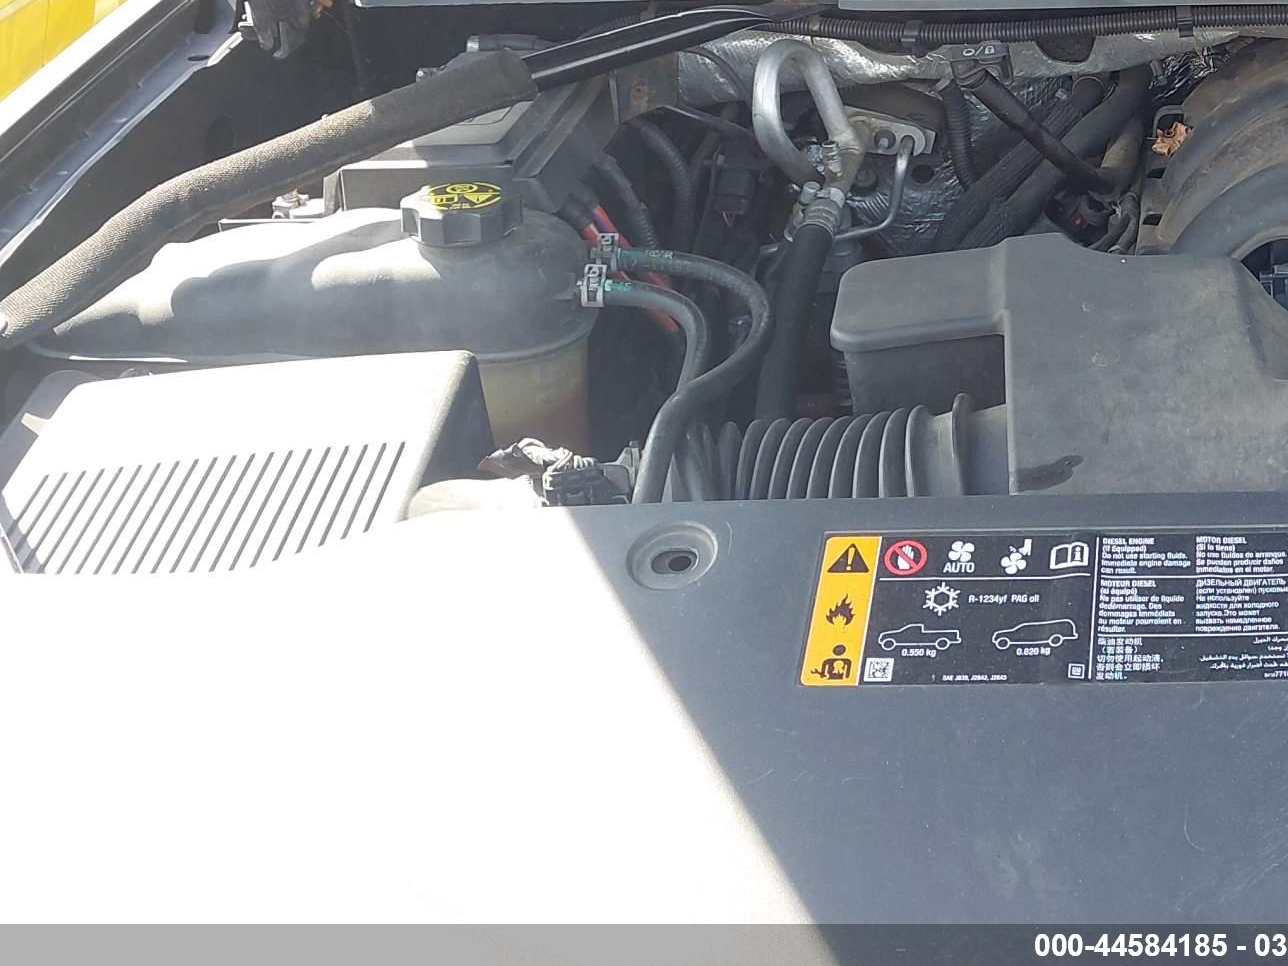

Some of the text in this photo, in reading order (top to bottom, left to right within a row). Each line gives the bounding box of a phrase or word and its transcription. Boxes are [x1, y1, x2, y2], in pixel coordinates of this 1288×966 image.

[1102, 537, 1155, 545] DIESEL ENGINE
[1196, 536, 1221, 544] MOTOR
[1111, 545, 1147, 553] Equipped)
[1139, 552, 1166, 560] starting
[1139, 560, 1162, 568] engine
[1163, 559, 1191, 568] damage
[1206, 559, 1232, 567] pueden
[1233, 558, 1262, 567] producir
[943, 562, 975, 573] AUTO
[1131, 580, 1157, 588] DIESEL
[1196, 578, 1286, 587] ДИЗЕЛЬНЫЙ ДВИГАТЕЛЬ
[968, 594, 1008, 604] R-1234yf
[1011, 594, 1028, 602] PAG
[1110, 595, 1124, 603] pas
[1161, 595, 1185, 603] liquide
[1098, 610, 1138, 618] dommages
[901, 648, 937, 658] 0.550 kg
[1040, 646, 1051, 656] kg
